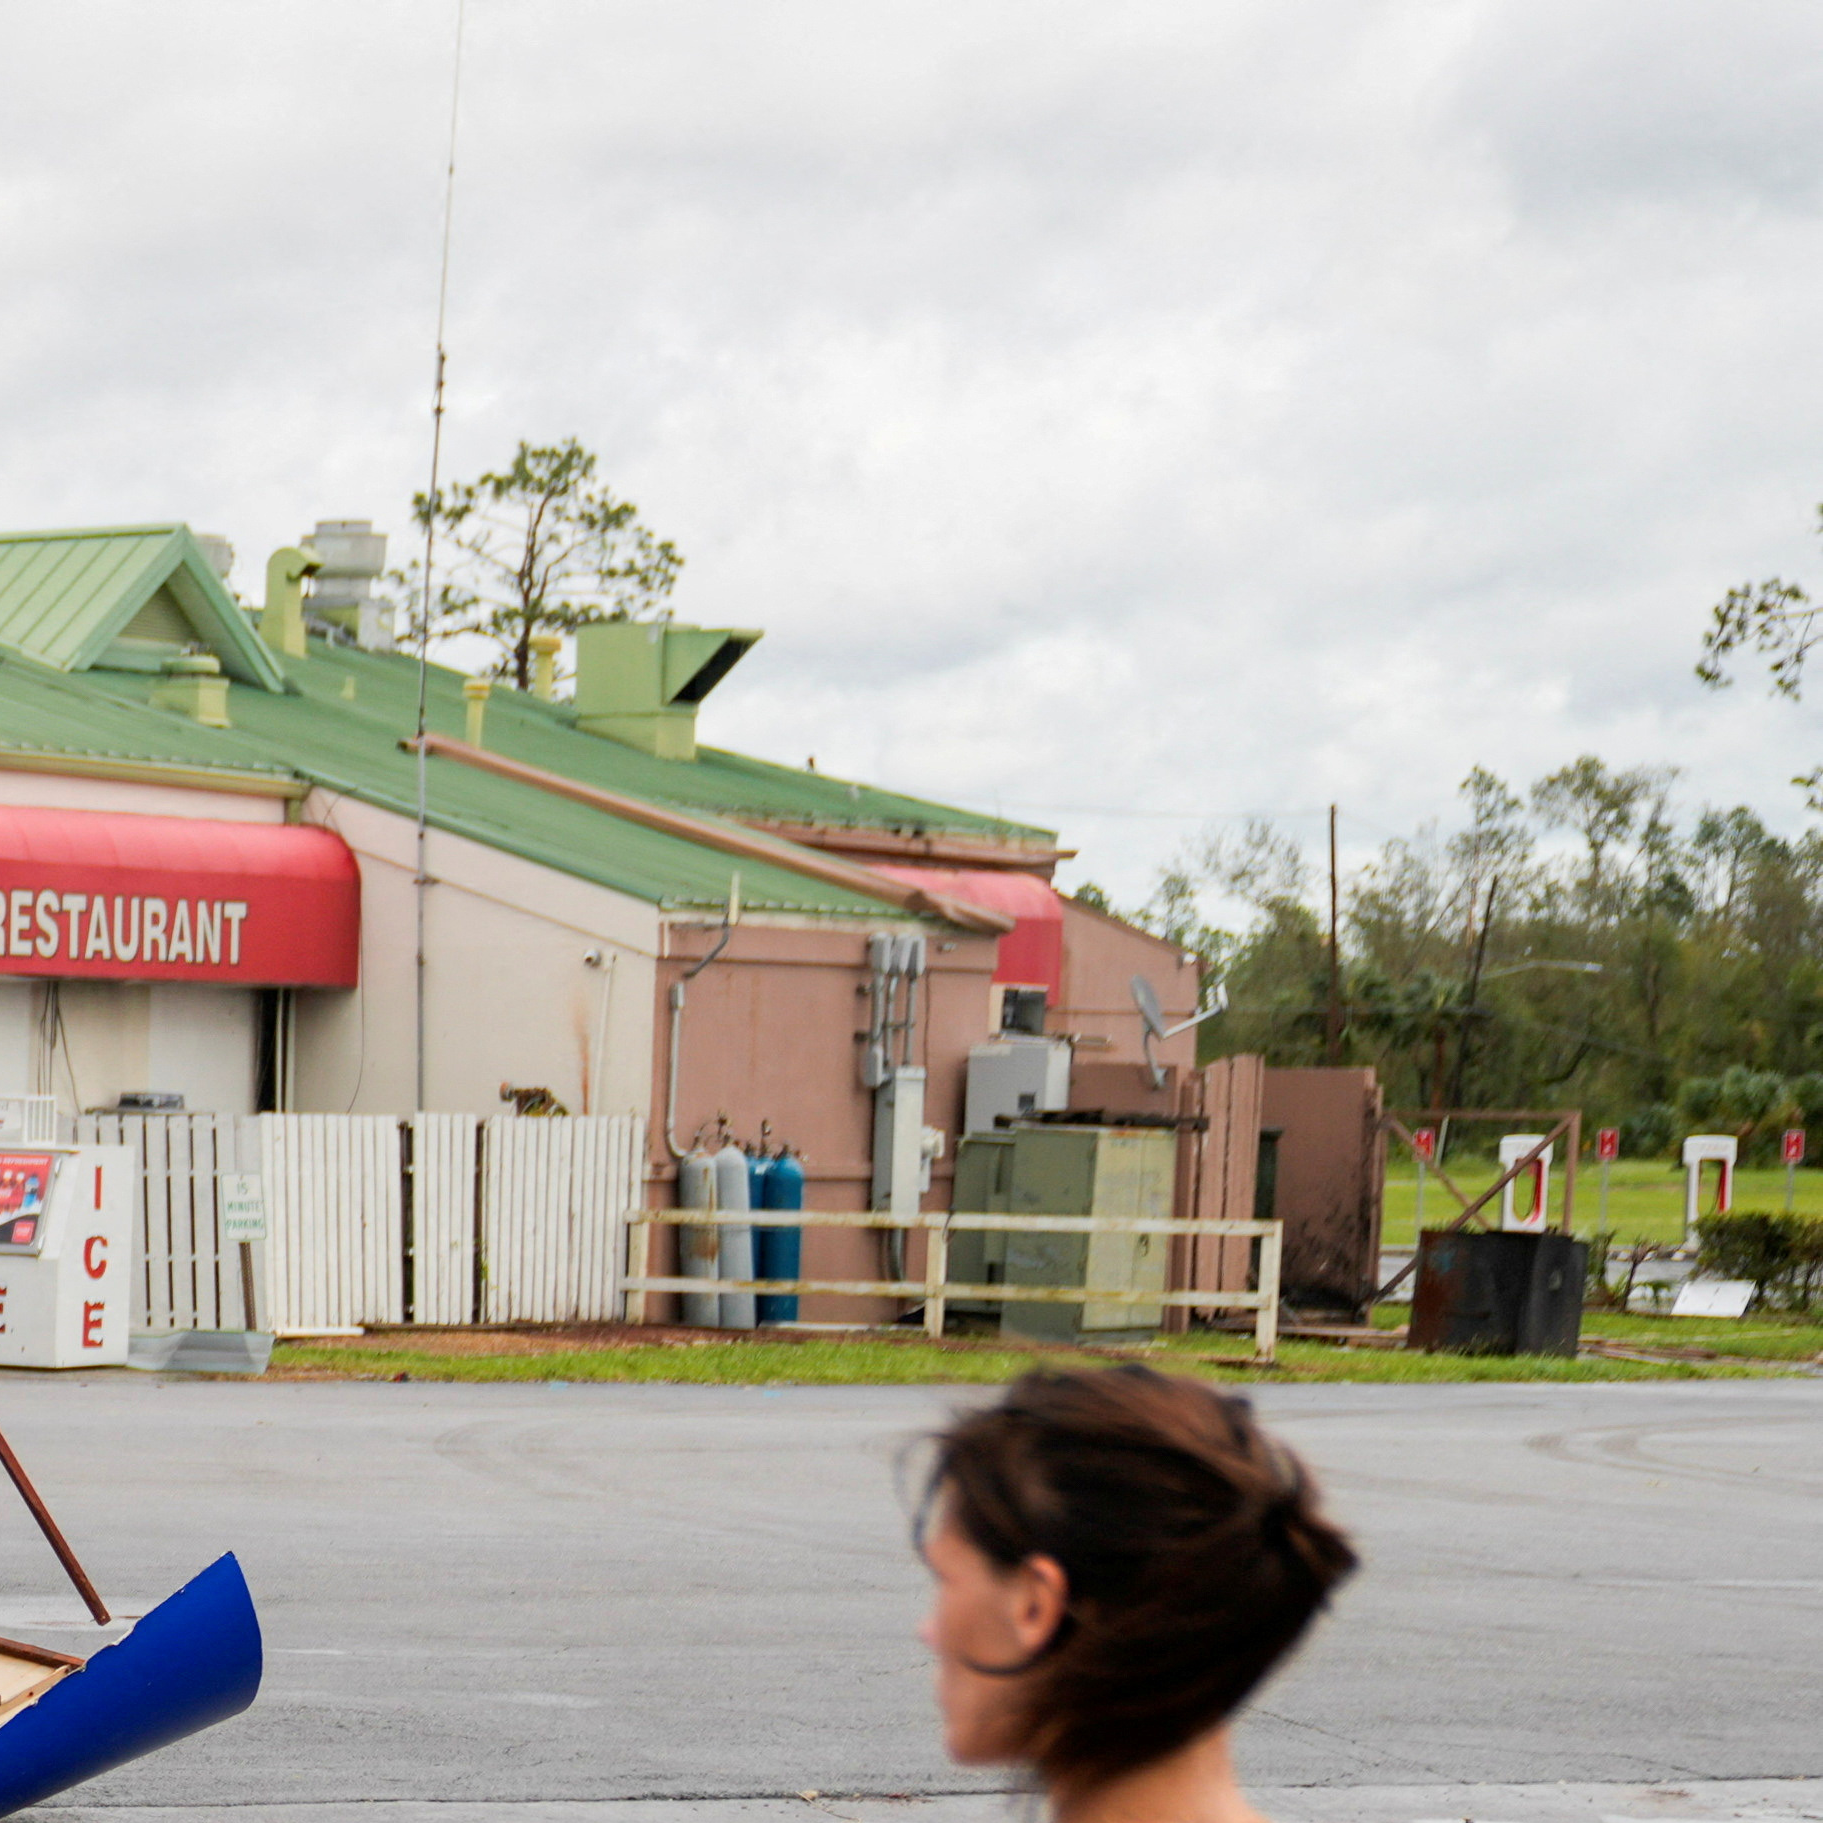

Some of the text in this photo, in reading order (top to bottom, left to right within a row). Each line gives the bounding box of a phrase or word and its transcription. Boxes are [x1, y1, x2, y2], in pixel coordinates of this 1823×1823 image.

[237, 1182, 249, 1195] 15
[227, 1201, 262, 1212] MINUTE
[226, 1218, 264, 1230] PARKING
[82, 1165, 108, 1348] ICE
